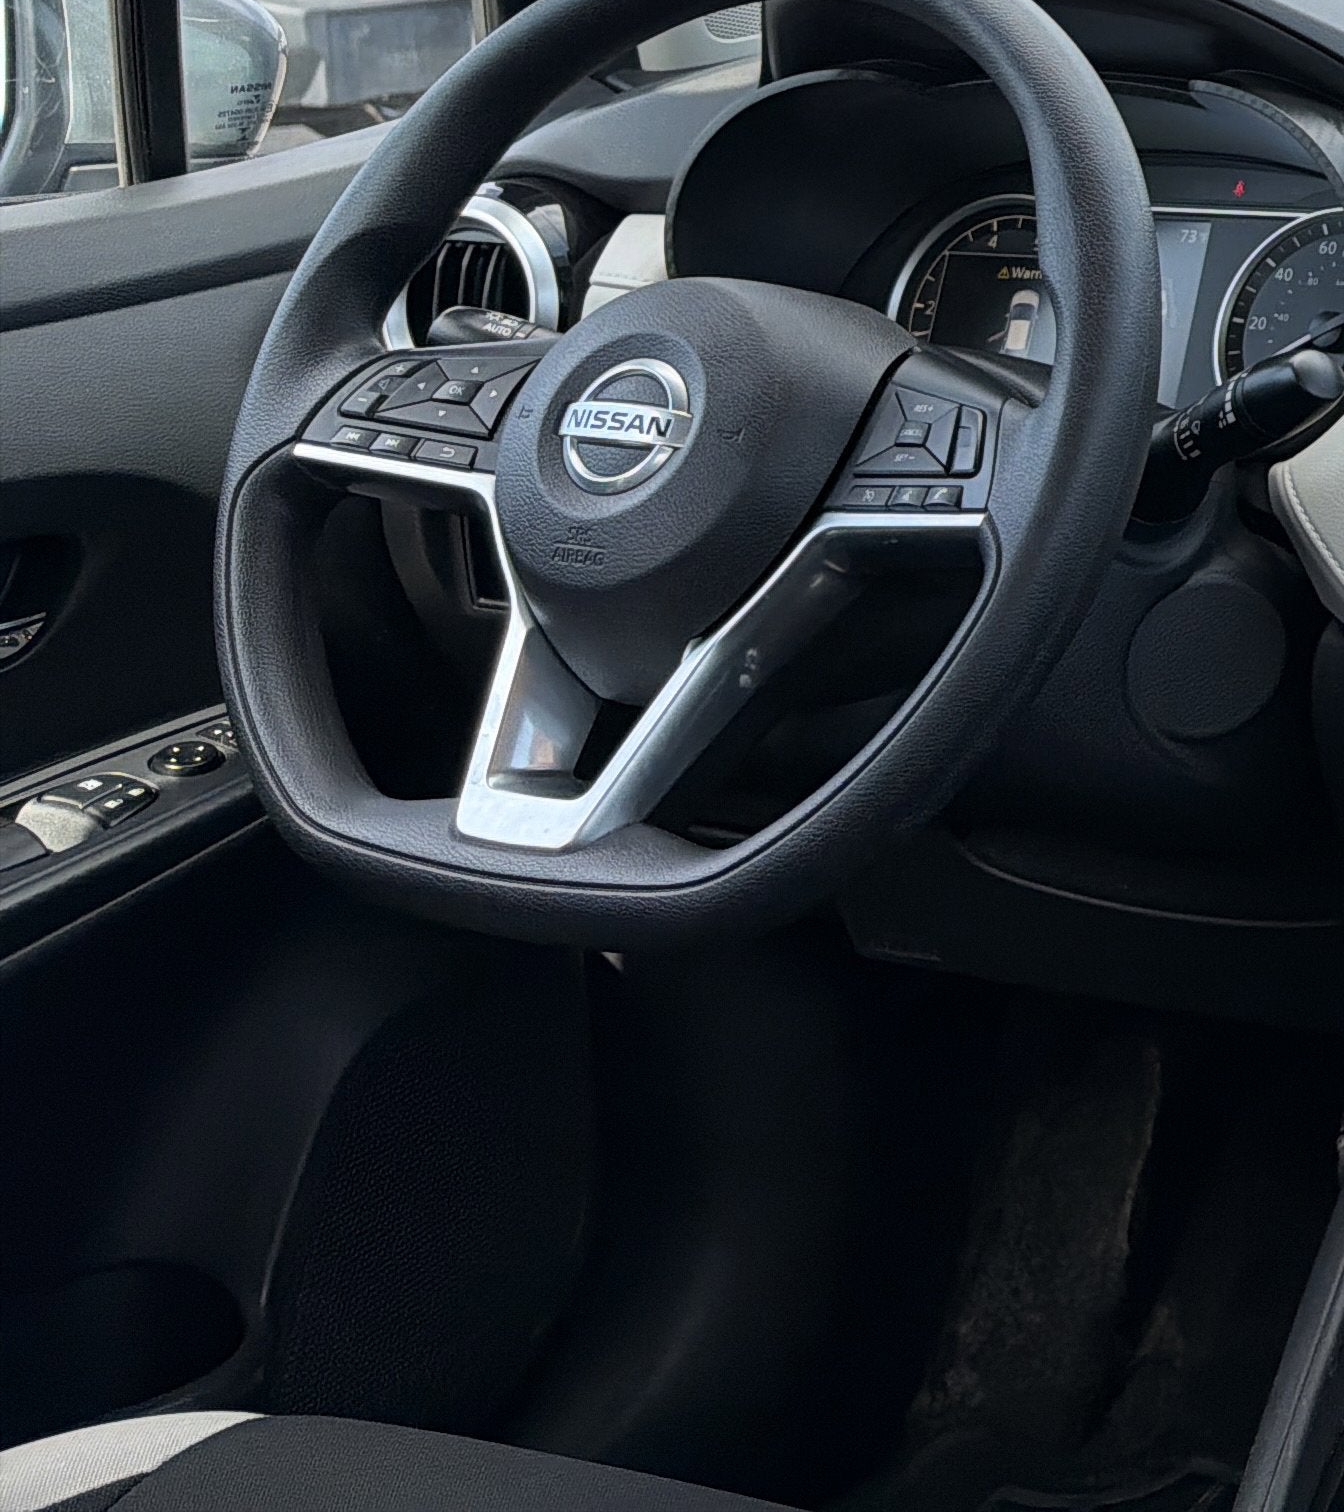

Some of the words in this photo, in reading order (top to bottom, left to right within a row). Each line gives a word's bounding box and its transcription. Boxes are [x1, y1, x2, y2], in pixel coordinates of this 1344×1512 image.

[1319, 241, 1337, 255] 60
[1275, 268, 1293, 282] 40
[925, 300, 936, 315] 2
[482, 323, 511, 336] AUTO
[1249, 316, 1267, 330] 20
[449, 384, 464, 396] OK
[567, 408, 673, 438] NISSAN
